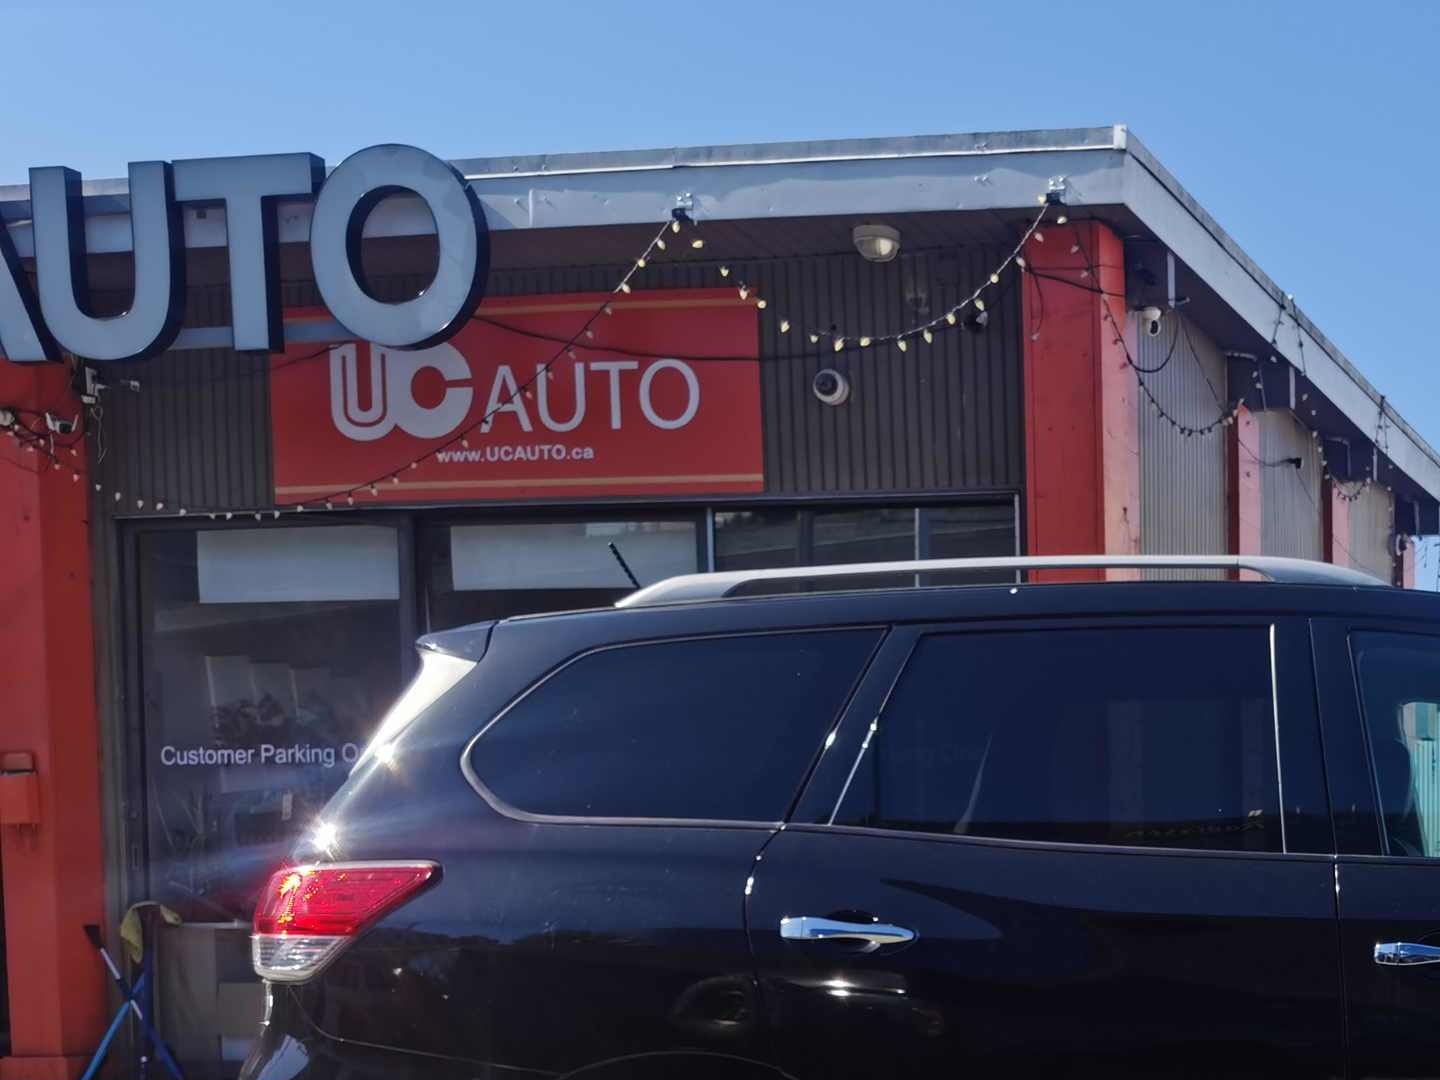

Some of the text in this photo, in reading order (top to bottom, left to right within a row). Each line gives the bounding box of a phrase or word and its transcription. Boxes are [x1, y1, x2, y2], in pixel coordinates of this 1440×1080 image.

[480, 359, 700, 433] AUTO
[436, 445, 594, 463] www.UCAUTO.ca
[160, 746, 253, 766] Customer
[260, 744, 335, 768] Parking
